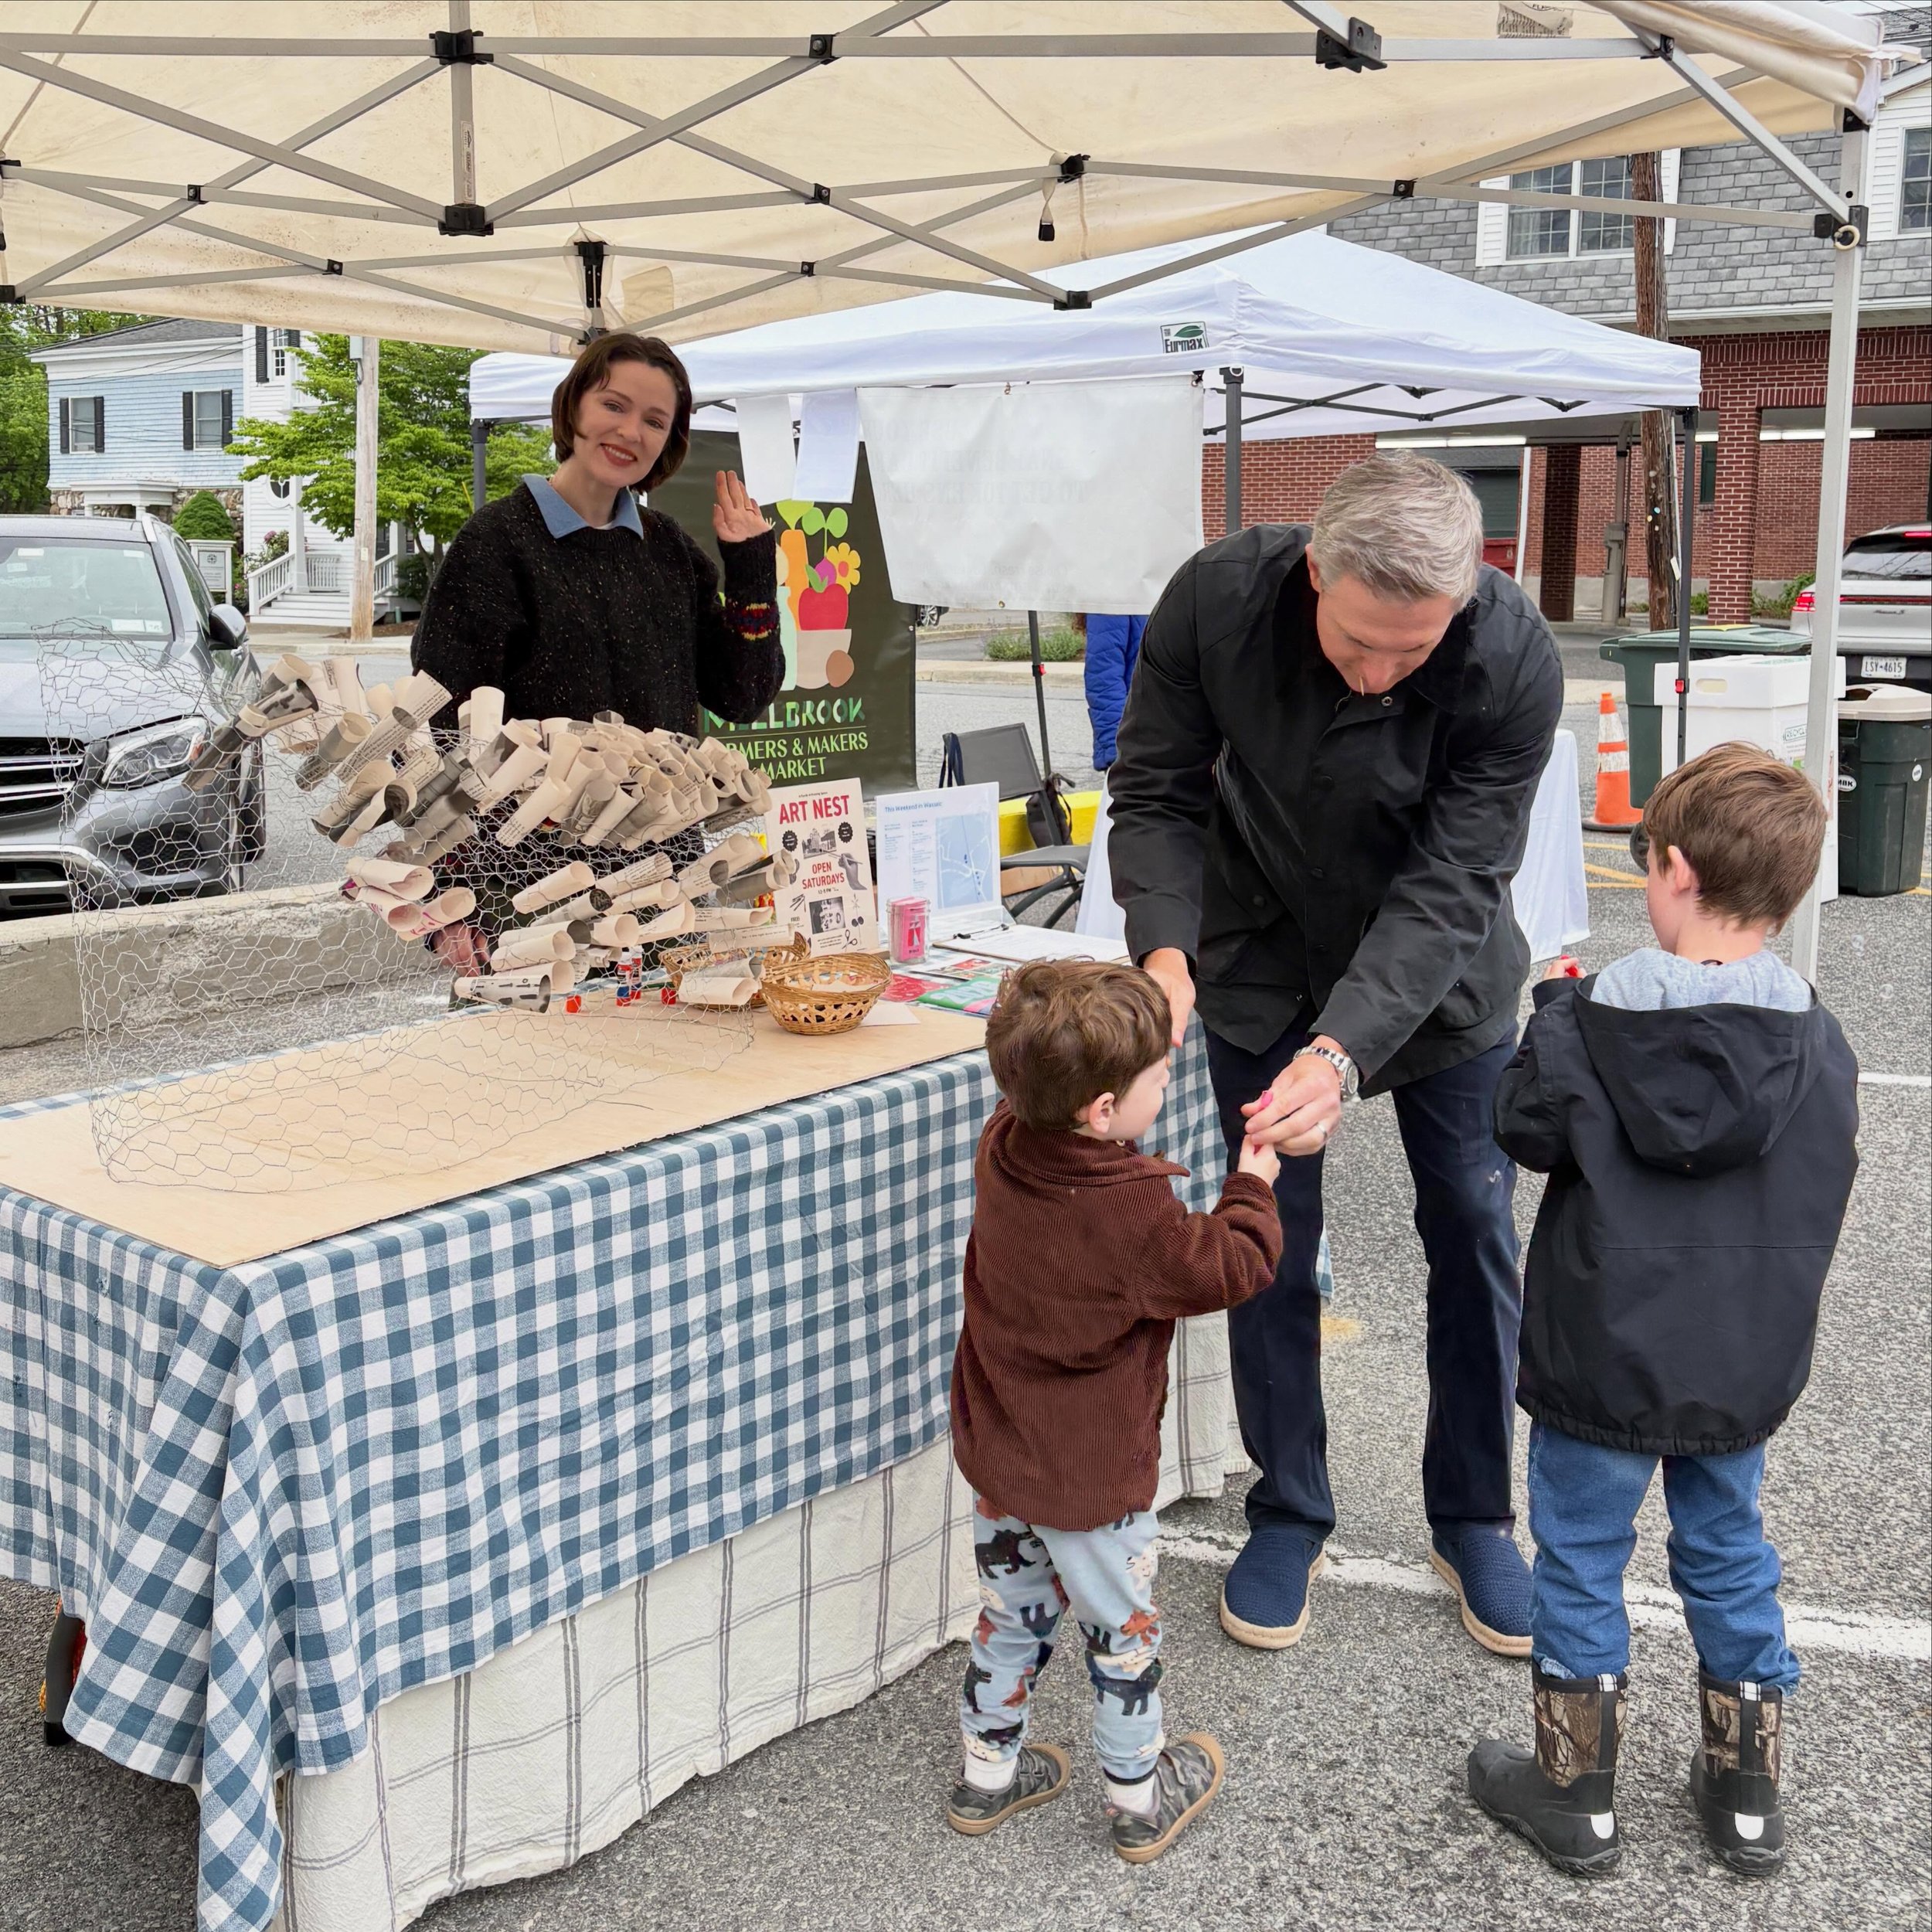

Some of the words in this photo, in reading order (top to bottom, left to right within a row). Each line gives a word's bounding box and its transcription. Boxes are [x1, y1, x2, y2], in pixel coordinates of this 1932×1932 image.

[1165, 338, 1203, 353] Eurmax
[704, 697, 866, 733] MLBROOK
[792, 737, 804, 756] &
[808, 732, 869, 756] MAKERS
[759, 757, 827, 780] MARKET
[779, 801, 808, 825] ART
[812, 795, 849, 819] NEST
[812, 862, 832, 874] OPEN
[802, 872, 845, 889] SATURDAYS
